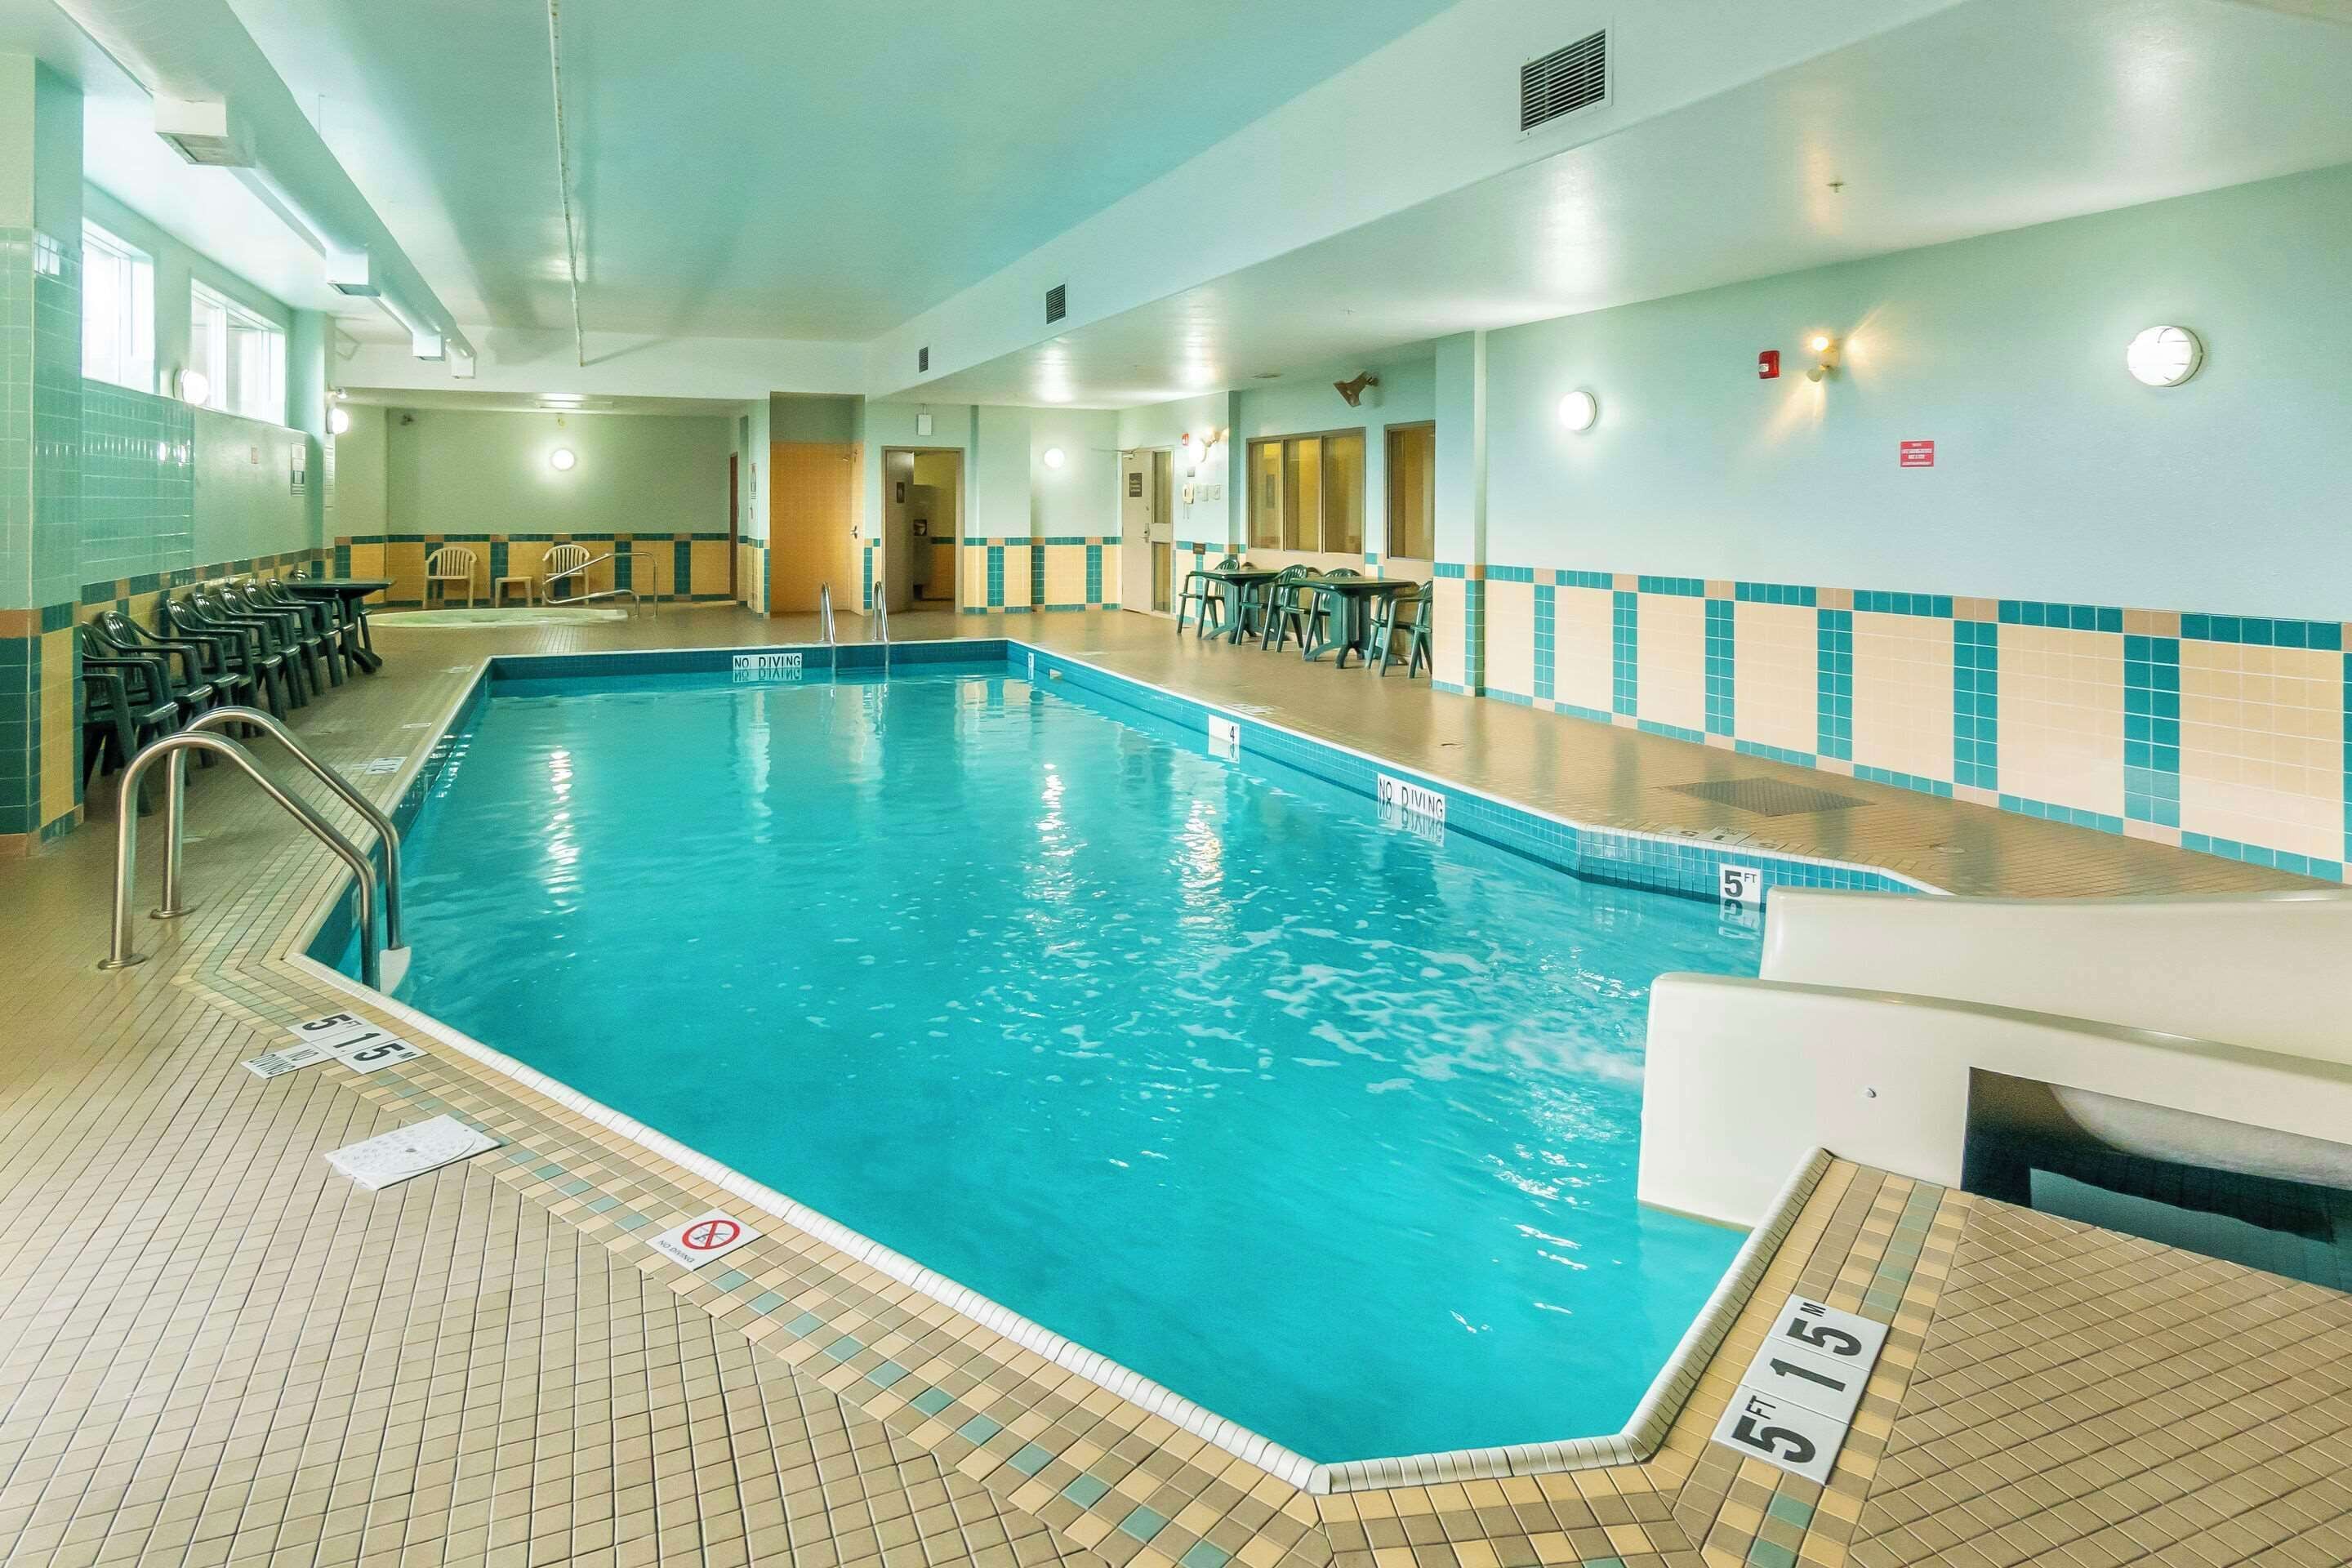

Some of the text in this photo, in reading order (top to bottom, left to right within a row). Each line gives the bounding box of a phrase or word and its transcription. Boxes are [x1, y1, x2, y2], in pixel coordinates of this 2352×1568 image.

[735, 655, 800, 667] NO DIVING
[1379, 778, 1443, 817] NO DIVING
[248, 1054, 296, 1075] DIVING
[658, 1240, 695, 1263] NO DIVING
